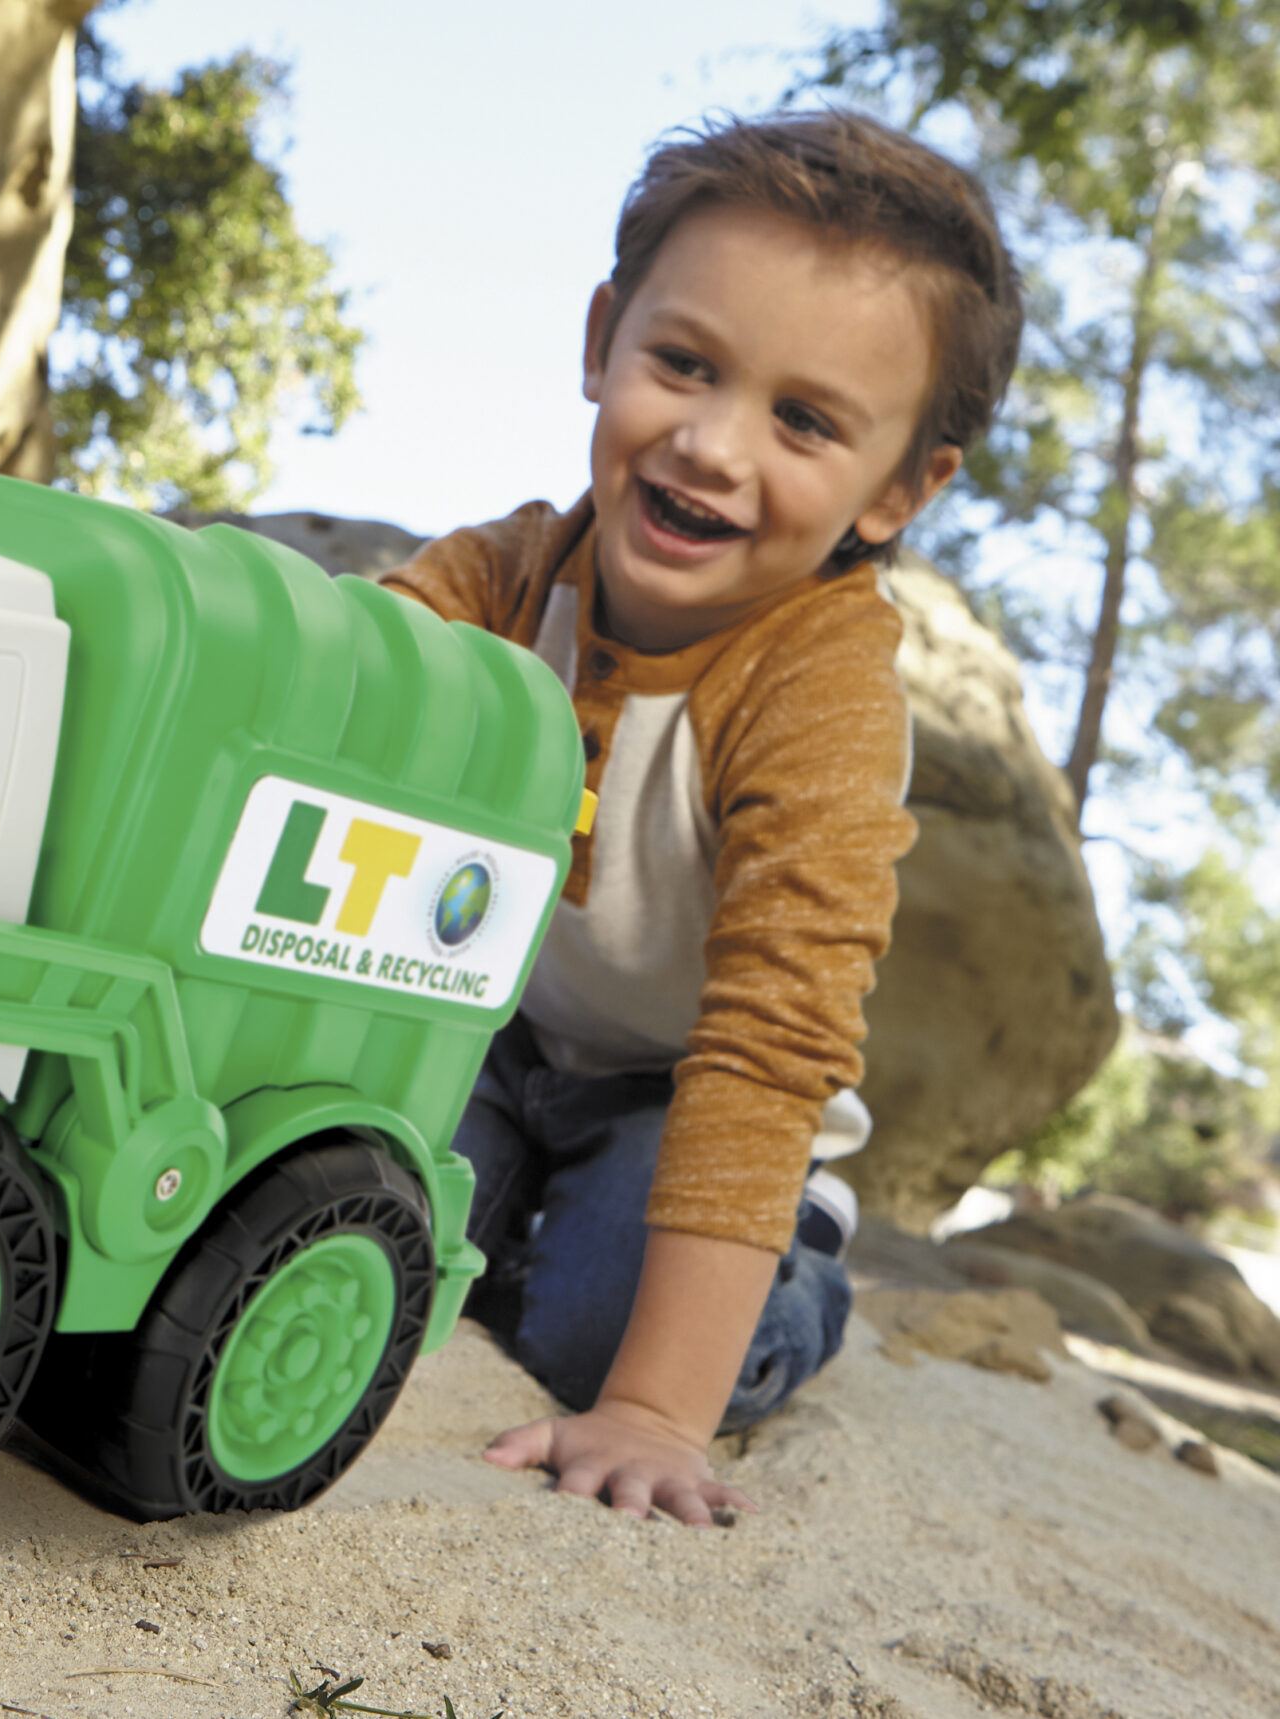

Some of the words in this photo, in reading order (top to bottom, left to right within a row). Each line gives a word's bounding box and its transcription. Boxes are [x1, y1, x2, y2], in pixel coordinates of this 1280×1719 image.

[254, 800, 422, 937] LT
[241, 924, 349, 972] DISPOSAL
[356, 949, 372, 975] &
[379, 954, 489, 998] RECYCLING
